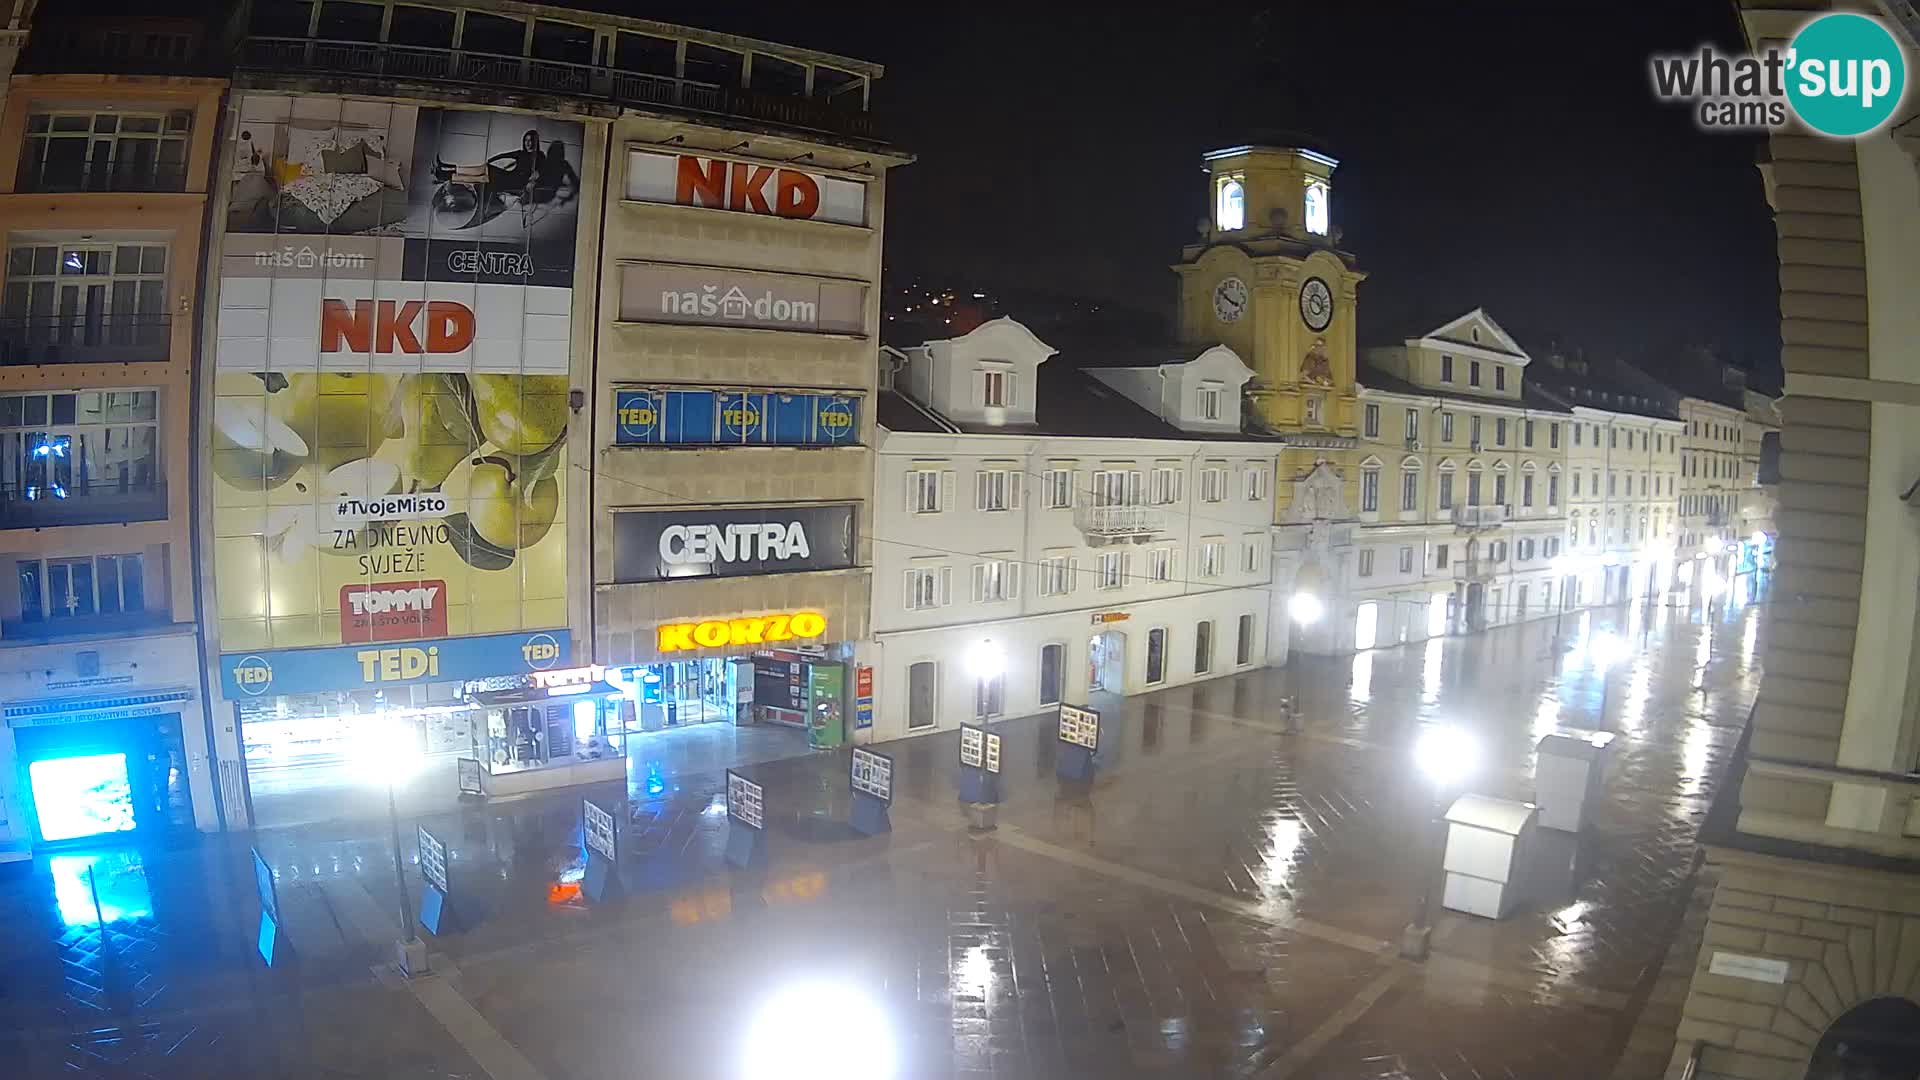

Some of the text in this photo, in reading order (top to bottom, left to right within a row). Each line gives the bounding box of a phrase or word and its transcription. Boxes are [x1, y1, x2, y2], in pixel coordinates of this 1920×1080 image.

[677, 155, 820, 219] NKD
[255, 247, 365, 269] naš dom
[448, 250, 534, 276] CENTRA
[662, 286, 816, 322] naš dom
[321, 299, 477, 353] NKD
[619, 409, 657, 424] TEDi
[724, 410, 759, 425] TEDi
[820, 411, 852, 427] TEDi
[338, 498, 446, 516] #TvojeMisto
[333, 524, 450, 549] ZA DNEVNO
[659, 521, 810, 564] CENTRA
[360, 548, 425, 575] SVJEŽE
[348, 587, 438, 615] TOMMY
[657, 611, 827, 653] KORZO
[357, 646, 440, 682] TEDi
[522, 644, 560, 660] TEDi
[234, 667, 272, 684] TEDi
